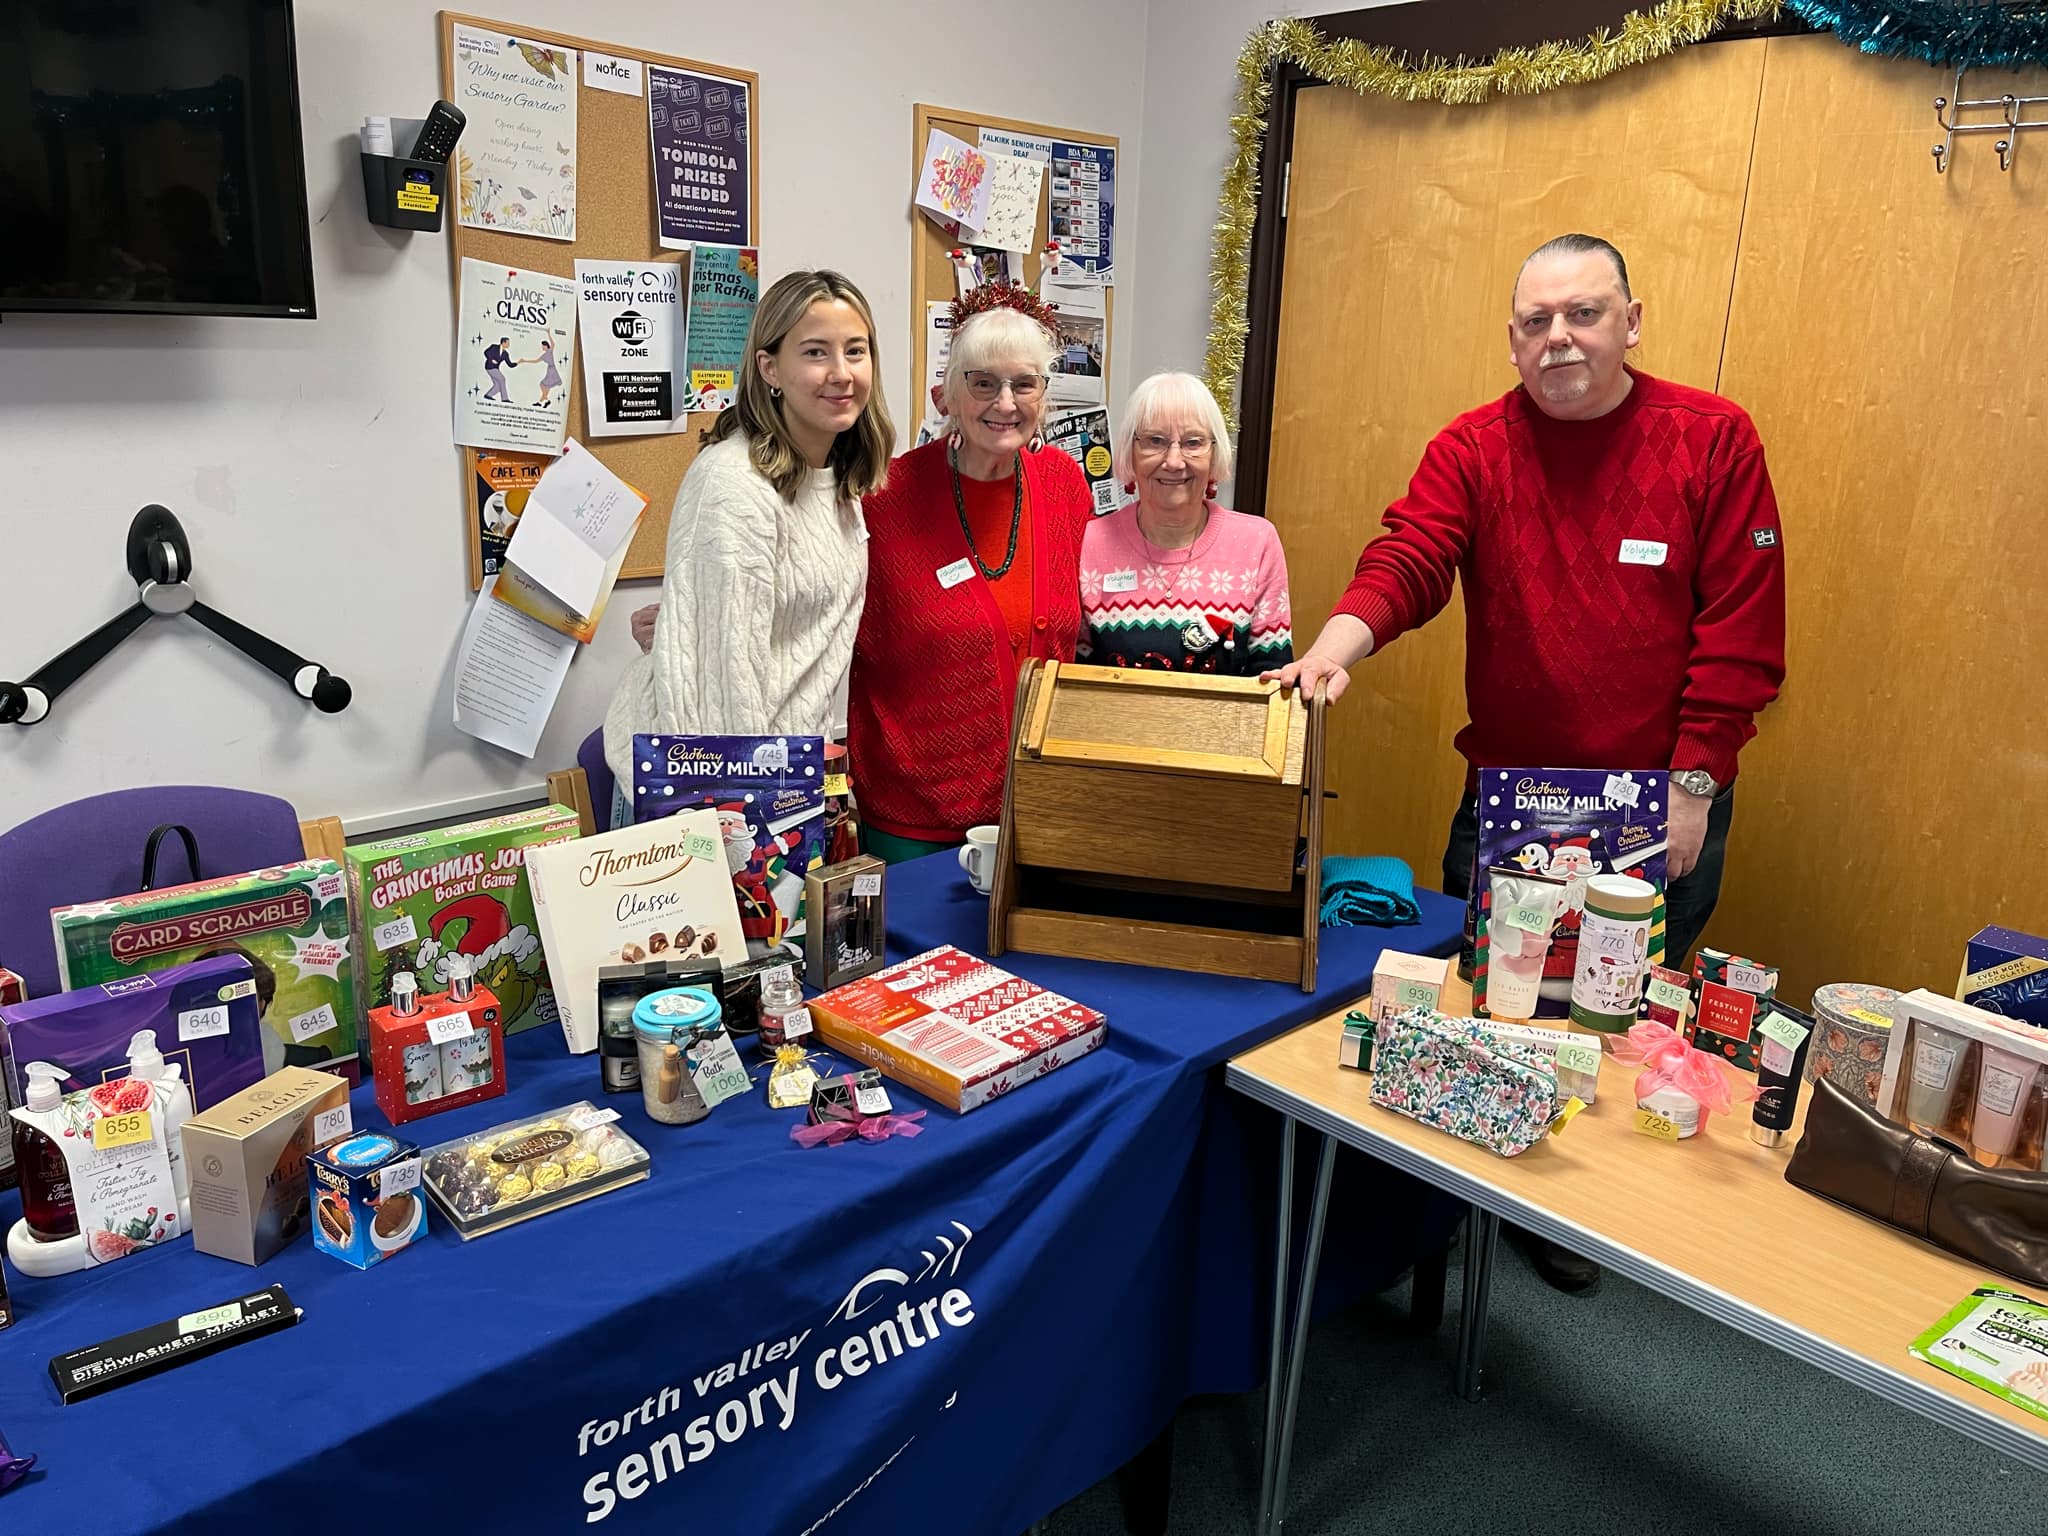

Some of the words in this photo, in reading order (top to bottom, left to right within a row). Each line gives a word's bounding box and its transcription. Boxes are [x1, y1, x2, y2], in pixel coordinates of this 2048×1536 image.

[468, 61, 500, 81] Why
[502, 73, 518, 82] not
[520, 76, 544, 88] visit
[545, 81, 566, 92] our
[596, 64, 630, 79] NOTICE
[465, 83, 513, 105] Sensory
[514, 93, 567, 114] Garden?
[983, 134, 1010, 144] FALKIRK
[1012, 139, 1034, 150] SENIOR
[662, 147, 738, 170] TOMBOLA
[1013, 150, 1029, 158] DEAF
[674, 166, 726, 186] PRIZES
[671, 184, 730, 203] NEEDED
[674, 202, 706, 212] donations
[708, 206, 738, 216] welcome!
[582, 273, 604, 284] forth
[606, 274, 634, 288] valley
[694, 268, 742, 284] ristmas
[504, 286, 545, 306] DANCE
[584, 289, 634, 306] sensory
[638, 290, 676, 304] centre
[714, 282, 756, 302] Raffle
[497, 301, 548, 326] CLASS
[621, 348, 648, 357] ZONE
[490, 466, 516, 478] CAFE
[668, 744, 723, 762] Cadbury
[760, 750, 783, 760] 745
[668, 762, 724, 778] DAIRY
[727, 761, 772, 777] MILK
[1514, 777, 1570, 796] Cadbury
[1613, 782, 1634, 796] 730
[1514, 795, 1570, 810] DAIRY
[1574, 796, 1618, 811] MILK
[545, 820, 578, 832] AQUARIUS
[692, 838, 713, 852] 875
[372, 858, 402, 882] THE
[579, 841, 685, 887] Thorntons
[321, 884, 338, 893] RULES
[372, 854, 484, 909] GRINCHMAS
[434, 878, 476, 903] Board
[482, 872, 517, 890] Game
[859, 879, 876, 889] 775
[616, 892, 681, 923] Classic
[116, 926, 182, 954] CARD
[189, 898, 306, 938] SCRAMBLE
[1519, 910, 1543, 926] 900
[383, 922, 410, 940] 635
[323, 944, 338, 952] FOR
[1600, 936, 1625, 950] 770
[300, 950, 324, 959] FAMILY
[326, 951, 342, 960] AND
[302, 957, 334, 966] FRIENDS!
[768, 970, 790, 980] 675
[1735, 970, 1760, 985] 670
[1975, 964, 2032, 988] CHOCOLATEY
[1977, 970, 2000, 982] EVEN
[2001, 960, 2026, 976] MORE
[1408, 988, 1433, 1002] 930
[1659, 986, 1684, 1002] 915
[1708, 998, 1744, 1014] FESTIVE
[189, 1012, 222, 1029] 640
[300, 1010, 329, 1031] 645
[437, 1018, 465, 1032] 665
[484, 1012, 494, 1020] £6
[788, 1013, 808, 1030] 695
[1710, 1012, 1740, 1026] TRIVIA
[1520, 1026, 1582, 1041] Angels
[1774, 1020, 1799, 1040] 905
[861, 1042, 897, 1067] SINGLE
[1568, 1050, 1594, 1067] 925
[702, 1063, 725, 1080] Bath
[711, 1072, 746, 1094] 1000
[236, 1079, 320, 1126] BELGIAN
[105, 1118, 140, 1136] 655
[322, 1110, 344, 1130] 780
[1643, 1114, 1672, 1132] 725
[499, 1132, 564, 1157] FERRERO
[504, 1137, 568, 1162] COLLECTION
[76, 1142, 158, 1174] COLLECTIONS
[96, 1174, 129, 1191] Festive
[131, 1165, 148, 1182] Fig
[390, 1165, 415, 1184] 735
[90, 1191, 98, 1204] &
[98, 1177, 158, 1202] Pomegranate
[105, 1200, 126, 1210] HAND
[128, 1192, 148, 1204] WASH
[119, 1202, 144, 1214] CREAM
[195, 1308, 233, 1325] 890
[1995, 1308, 2030, 1326] tea
[1979, 1324, 2018, 1344] foot
[72, 1334, 196, 1383] DISHWASHER
[206, 1305, 281, 1336] MAGNET
[578, 1385, 680, 1456] forth
[692, 1328, 812, 1399] valley
[582, 1366, 800, 1523] sensory
[814, 1288, 976, 1390] centre
